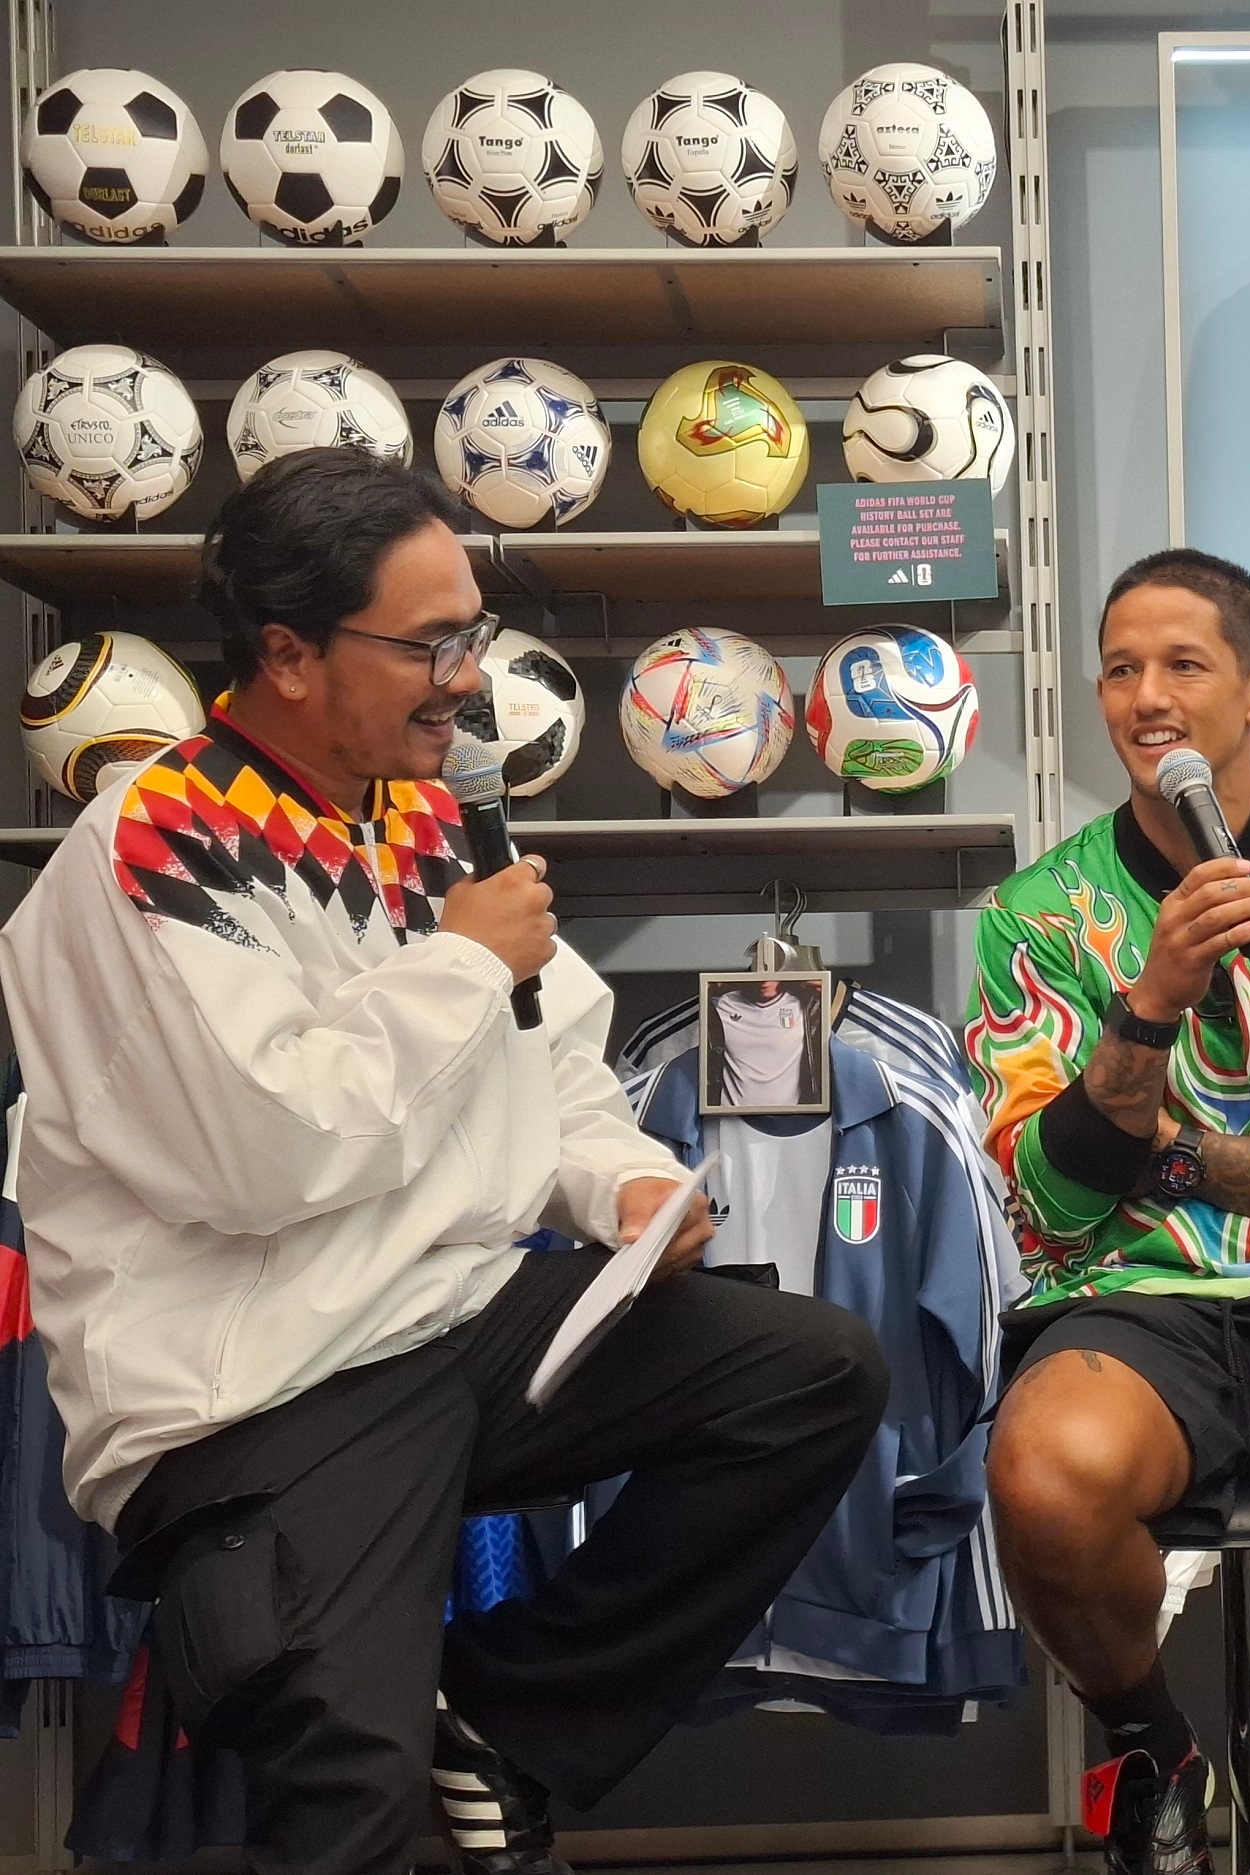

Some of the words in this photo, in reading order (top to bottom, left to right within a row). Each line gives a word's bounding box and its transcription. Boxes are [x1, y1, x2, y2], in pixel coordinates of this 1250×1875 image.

[73, 124, 136, 146] TELSTAR
[876, 124, 919, 134] azteca
[273, 131, 325, 143] TELSTAR
[479, 136, 523, 149] Tango
[675, 135, 719, 148] Tango
[482, 416, 525, 427] adidas
[68, 433, 114, 444] UNICO
[572, 445, 594, 478] adidas
[855, 498, 886, 508] ADIDAS
[888, 497, 905, 507] FIFA
[906, 496, 936, 506] WORLD
[938, 494, 955, 505] CUP
[861, 511, 894, 521] HISTORY
[897, 510, 917, 520] BALL
[919, 509, 934, 519] SET
[935, 508, 952, 518] ARE
[852, 524, 895, 535] AVAILABLE
[897, 523, 914, 533] FOR
[850, 538, 880, 549] PLEASE
[883, 536, 919, 547] CONTACT
[921, 535, 939, 545] OUR
[940, 534, 965, 544] STAFF
[854, 552, 870, 562] FOR
[872, 550, 909, 561] FURTHER
[838, 1182, 876, 1195] ITALIA
